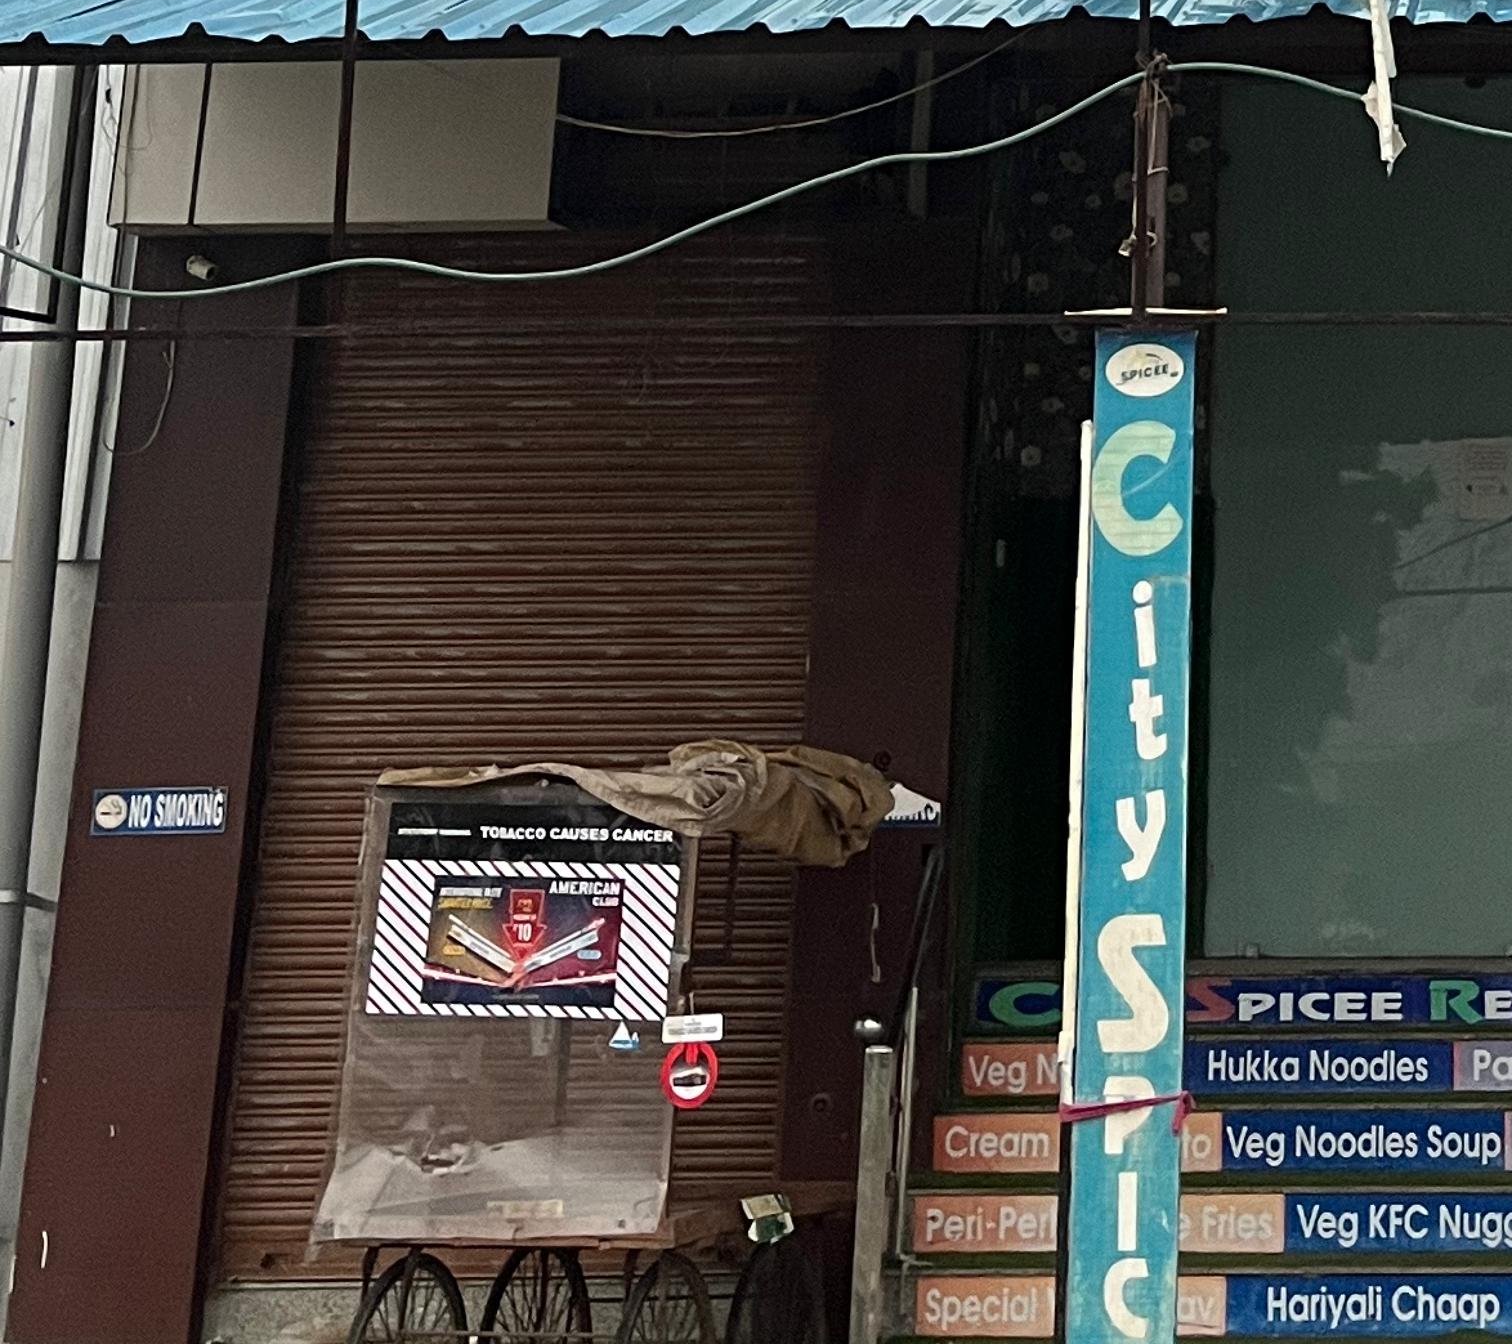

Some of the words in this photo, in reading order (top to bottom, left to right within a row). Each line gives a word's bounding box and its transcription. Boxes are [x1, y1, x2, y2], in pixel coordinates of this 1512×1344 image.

[1120, 363, 1170, 382] SPICEE
[127, 794, 152, 828] NO
[153, 792, 225, 828] SMOKING
[479, 825, 547, 841] TOBACCO
[549, 826, 609, 841] CAUSES
[612, 827, 674, 843] CANCER
[549, 880, 621, 895] AMERICAN
[591, 896, 620, 907] CLUB
[1187, 979, 1405, 1023] SPICEE
[967, 1053, 1027, 1093] Veg
[1207, 1049, 1300, 1083] Hukka
[1309, 1049, 1429, 1083] Noodles
[944, 1126, 1051, 1159] Cream
[1226, 1126, 1286, 1167] Veg
[1295, 1124, 1418, 1159] Noodles
[1426, 1124, 1502, 1167] Soup
[1203, 1204, 1274, 1240] Fries
[1296, 1204, 1359, 1248] Veg
[1368, 1204, 1430, 1239] KFC
[925, 1285, 1038, 1332] Special
[1266, 1285, 1382, 1330] Hariyali
[1391, 1286, 1502, 1330] Chaap
